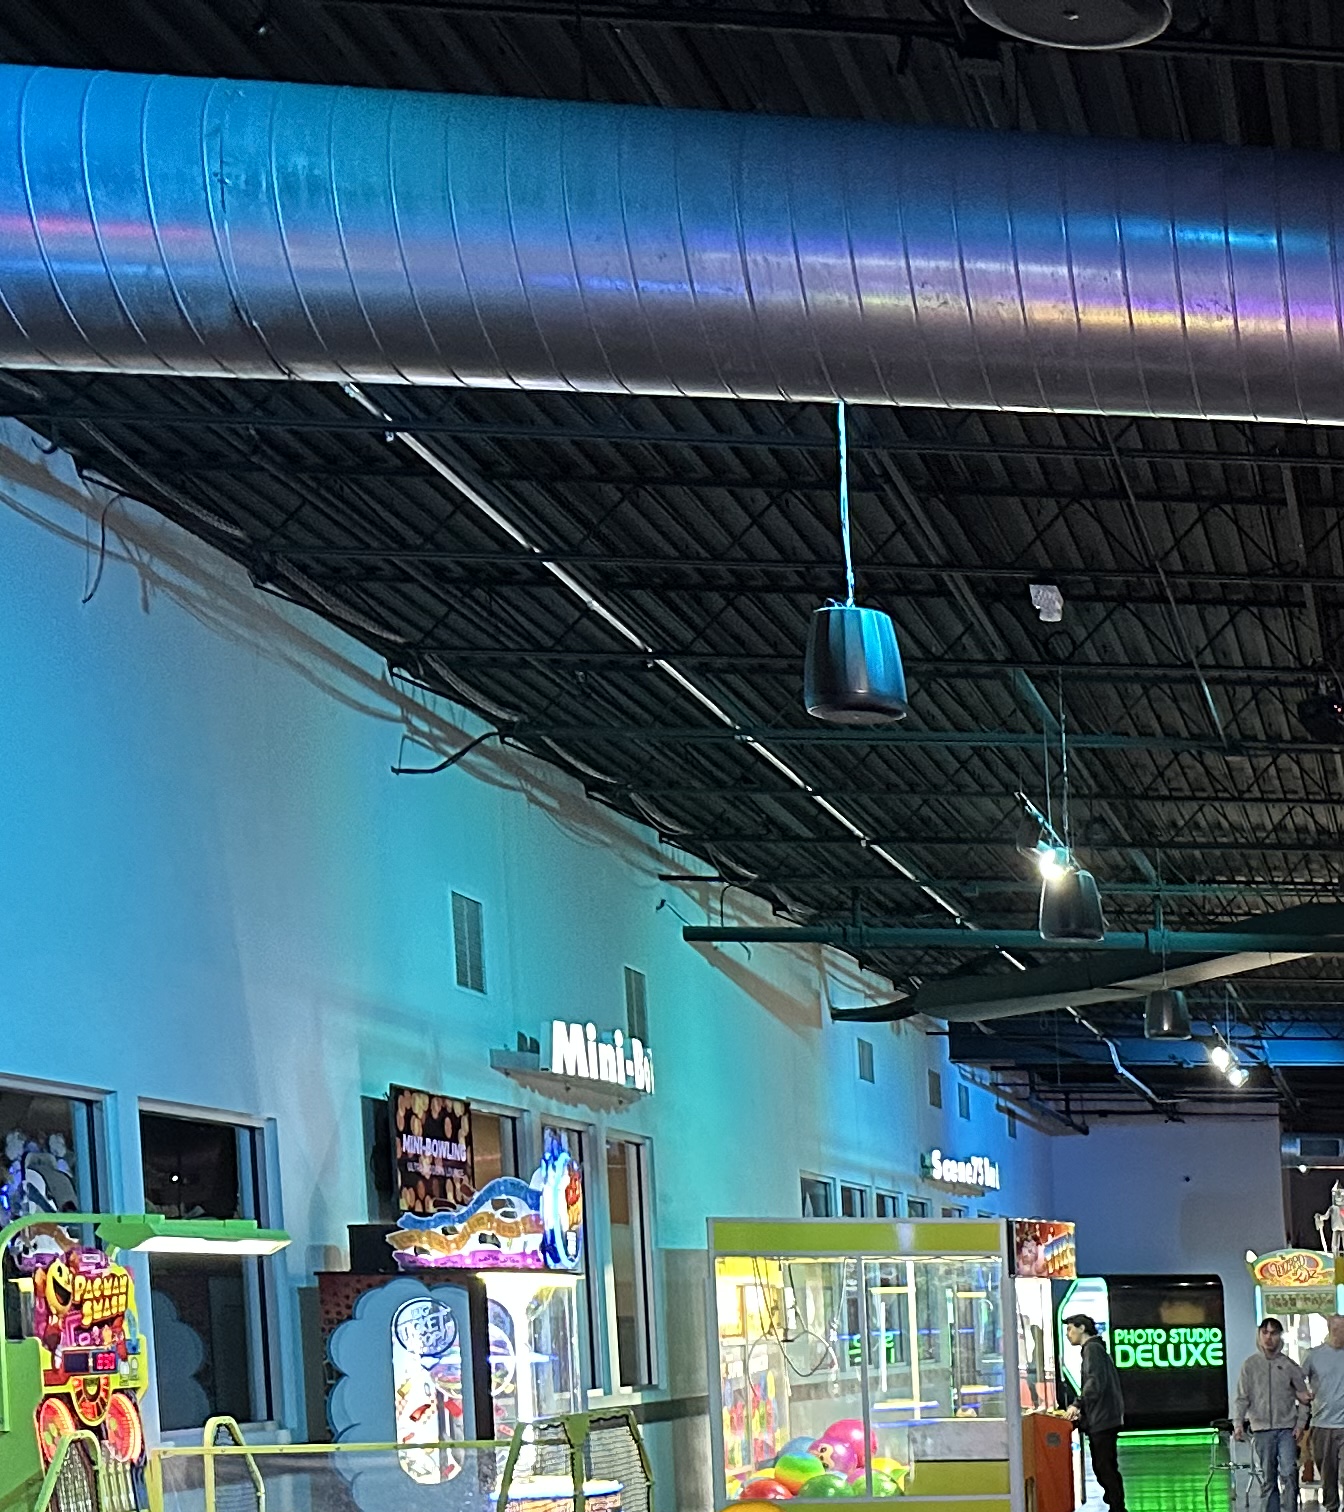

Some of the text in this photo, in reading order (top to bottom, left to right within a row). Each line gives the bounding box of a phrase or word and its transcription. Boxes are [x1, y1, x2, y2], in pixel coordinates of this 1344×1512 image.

[402, 1133, 467, 1163] MINI-BOWLING
[1114, 1327, 1222, 1344] PHOTO STUDIO
[1114, 1342, 1224, 1368] DELUXE
